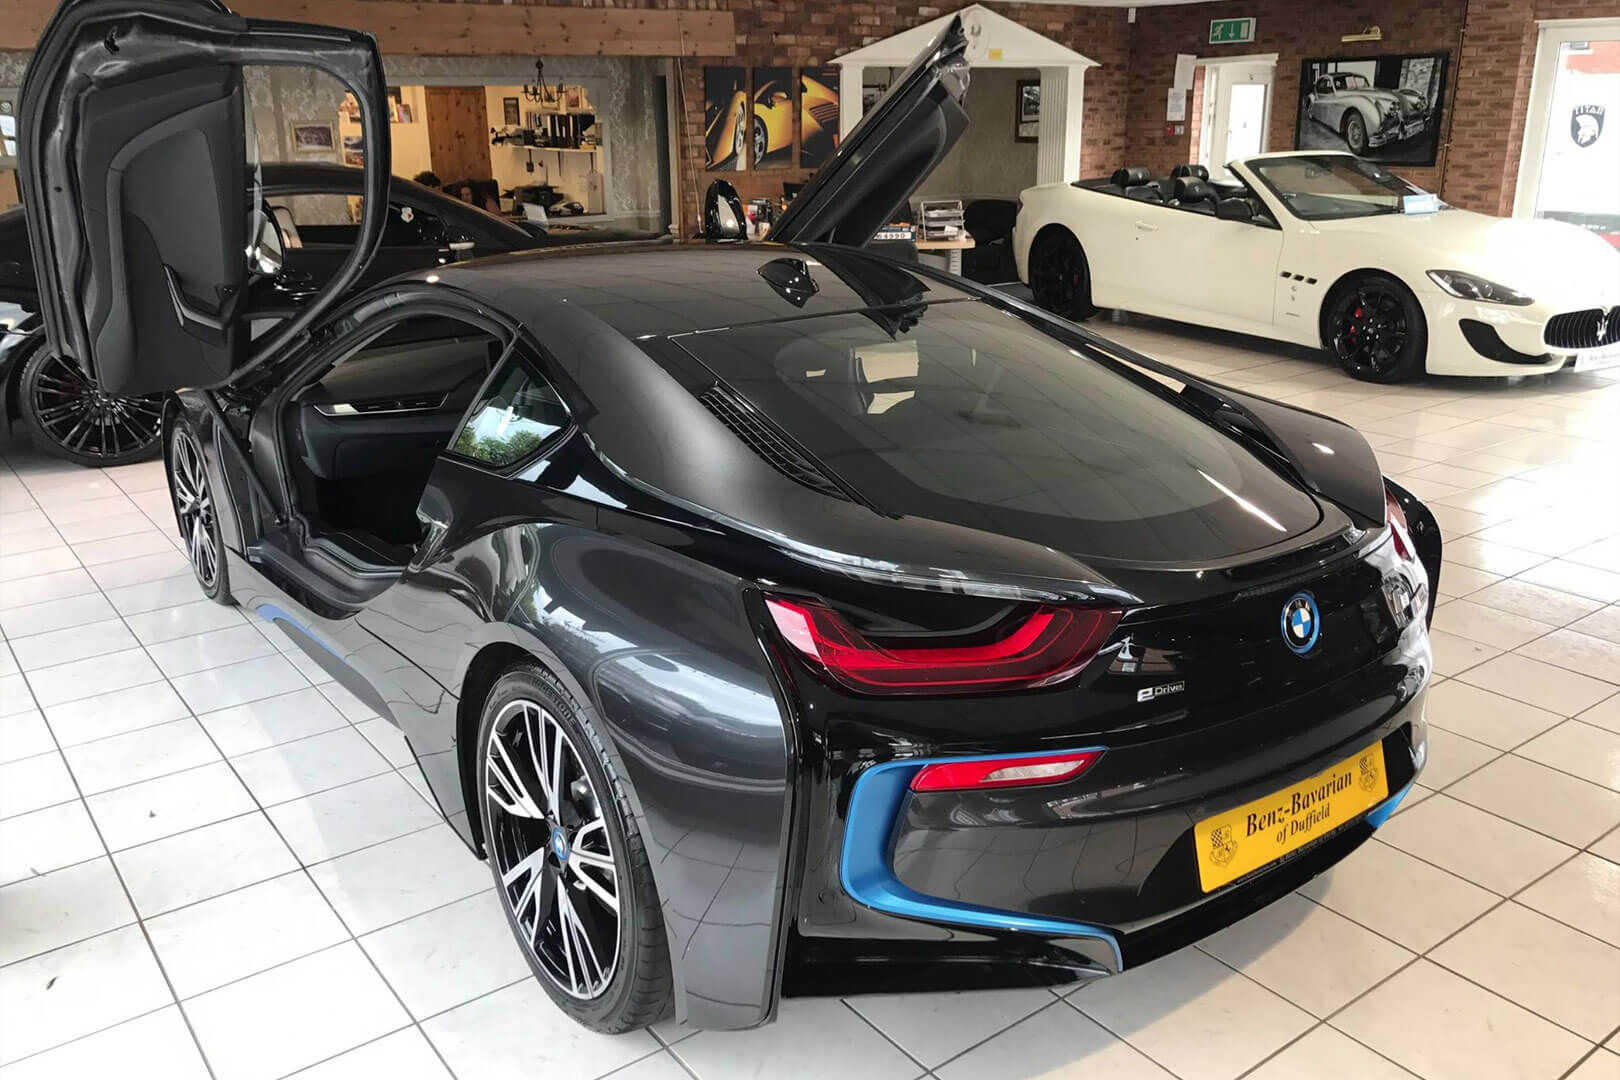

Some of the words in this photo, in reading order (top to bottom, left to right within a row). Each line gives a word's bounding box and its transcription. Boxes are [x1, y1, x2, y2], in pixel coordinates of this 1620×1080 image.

[1246, 771, 1352, 837] Benz-Bavarian
[1276, 822, 1289, 845] of
[1290, 802, 1330, 836] Duffield
